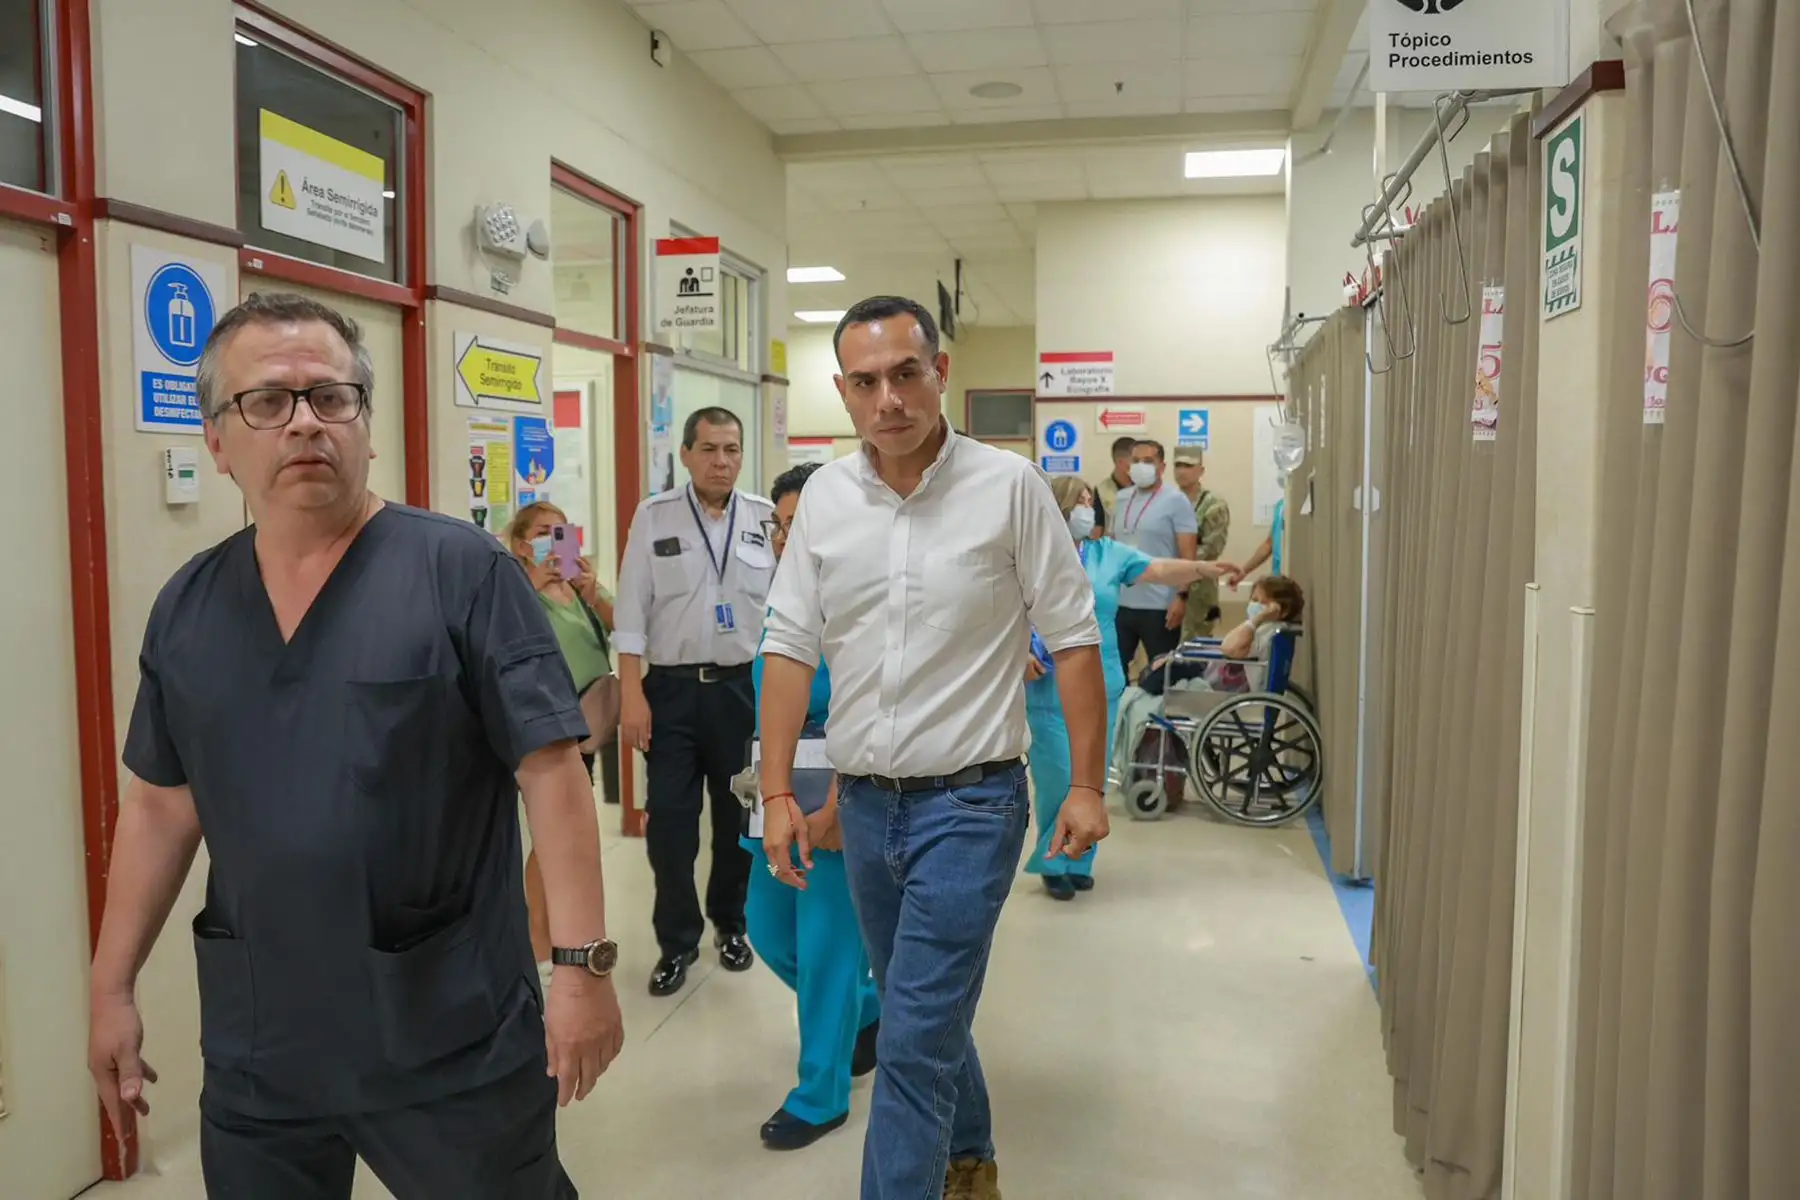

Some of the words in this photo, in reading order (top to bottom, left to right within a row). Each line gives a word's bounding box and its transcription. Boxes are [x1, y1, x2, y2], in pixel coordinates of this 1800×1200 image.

[1388, 33, 1451, 51] Tópico
[1388, 51, 1533, 68] Procedimientos
[302, 176, 325, 199] Área
[1549, 136, 1576, 238] S
[674, 305, 714, 315] Jefatura
[660, 318, 672, 328] de
[675, 317, 714, 327] Guardia
[1060, 367, 1113, 376] Laboratorio
[152, 378, 163, 389] ES
[164, 380, 197, 393] OBLIGAT
